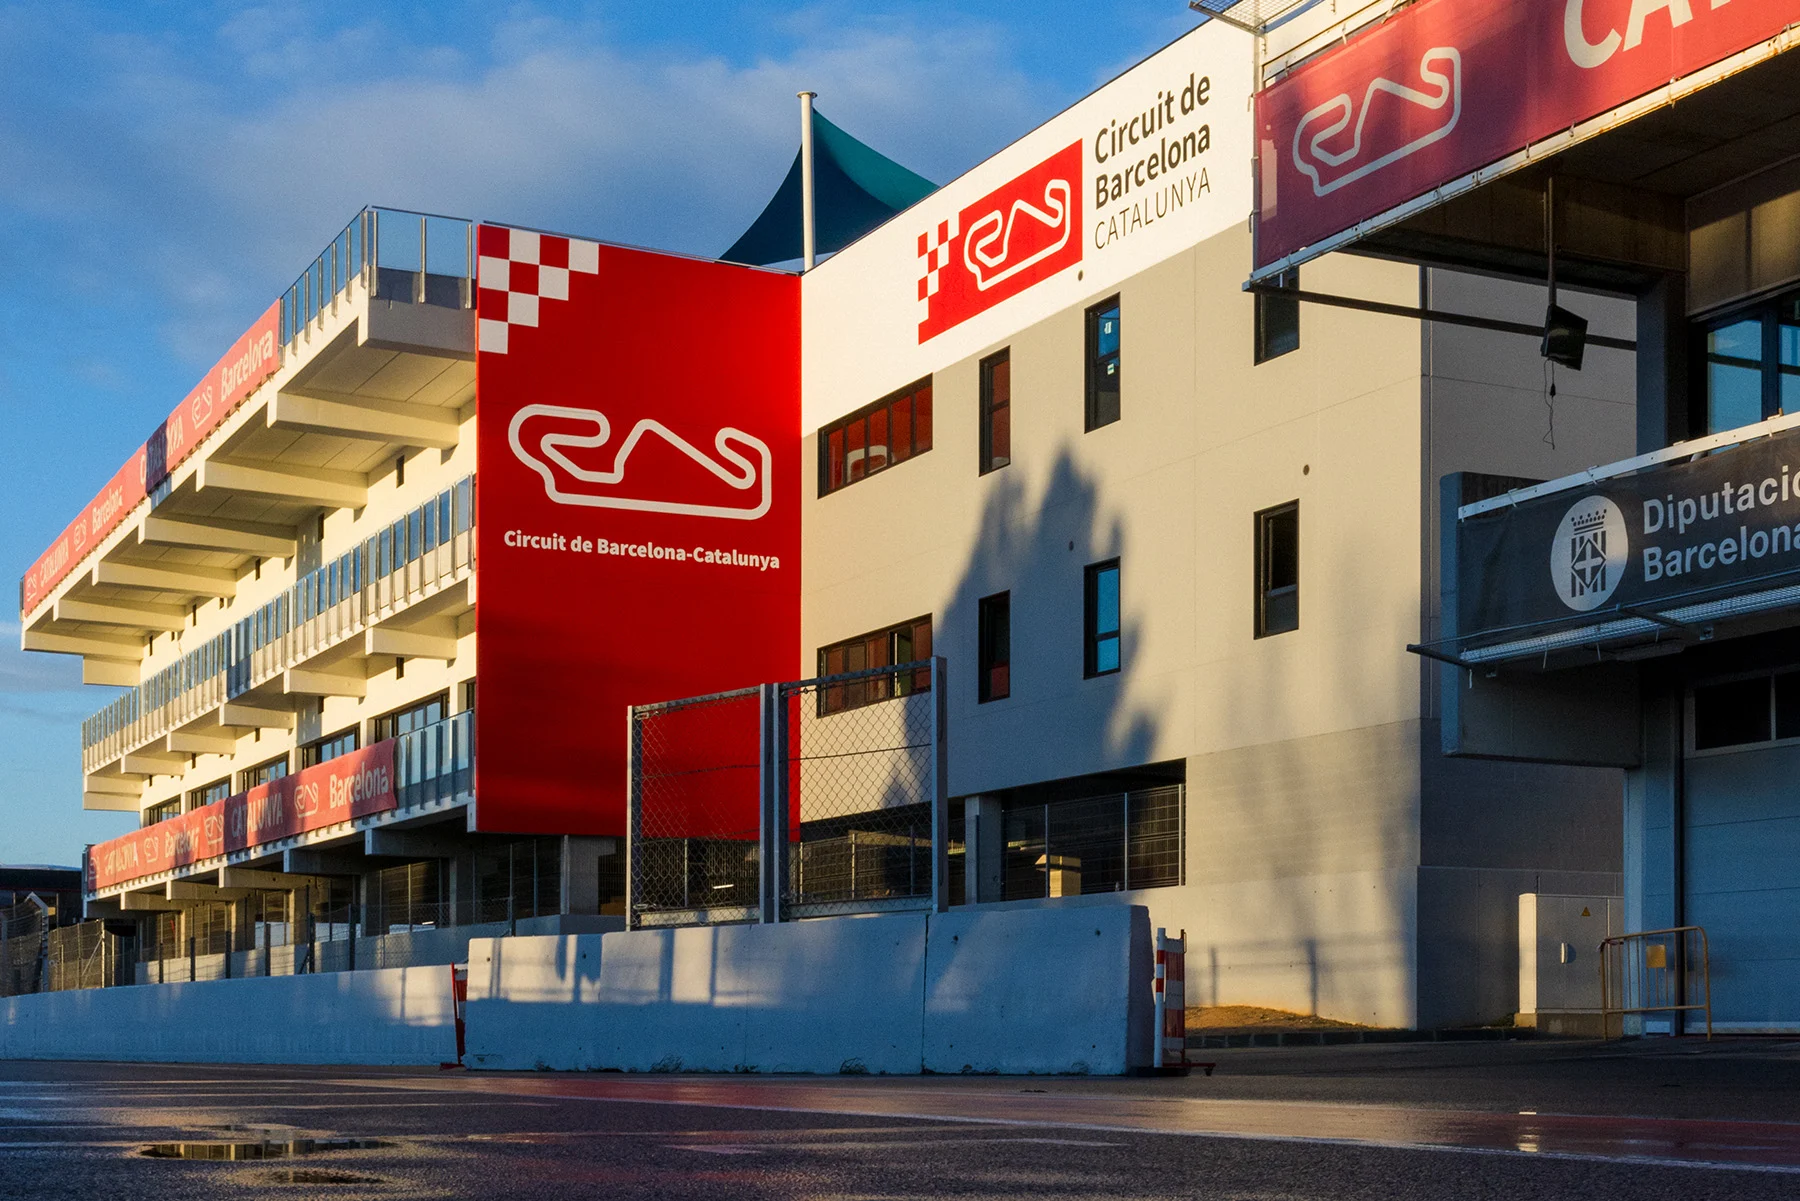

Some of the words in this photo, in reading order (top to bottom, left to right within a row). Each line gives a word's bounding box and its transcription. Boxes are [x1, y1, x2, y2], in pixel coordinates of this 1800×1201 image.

[1095, 90, 1175, 164] Circuit
[1180, 72, 1211, 116] de
[1095, 124, 1211, 210] Barcelona
[1095, 167, 1211, 250] CATALUNYA
[504, 529, 566, 551] Circuit
[570, 536, 593, 553] de
[597, 538, 780, 571] Barcelona-Catalunya
[231, 793, 284, 838] CATALUNYA
